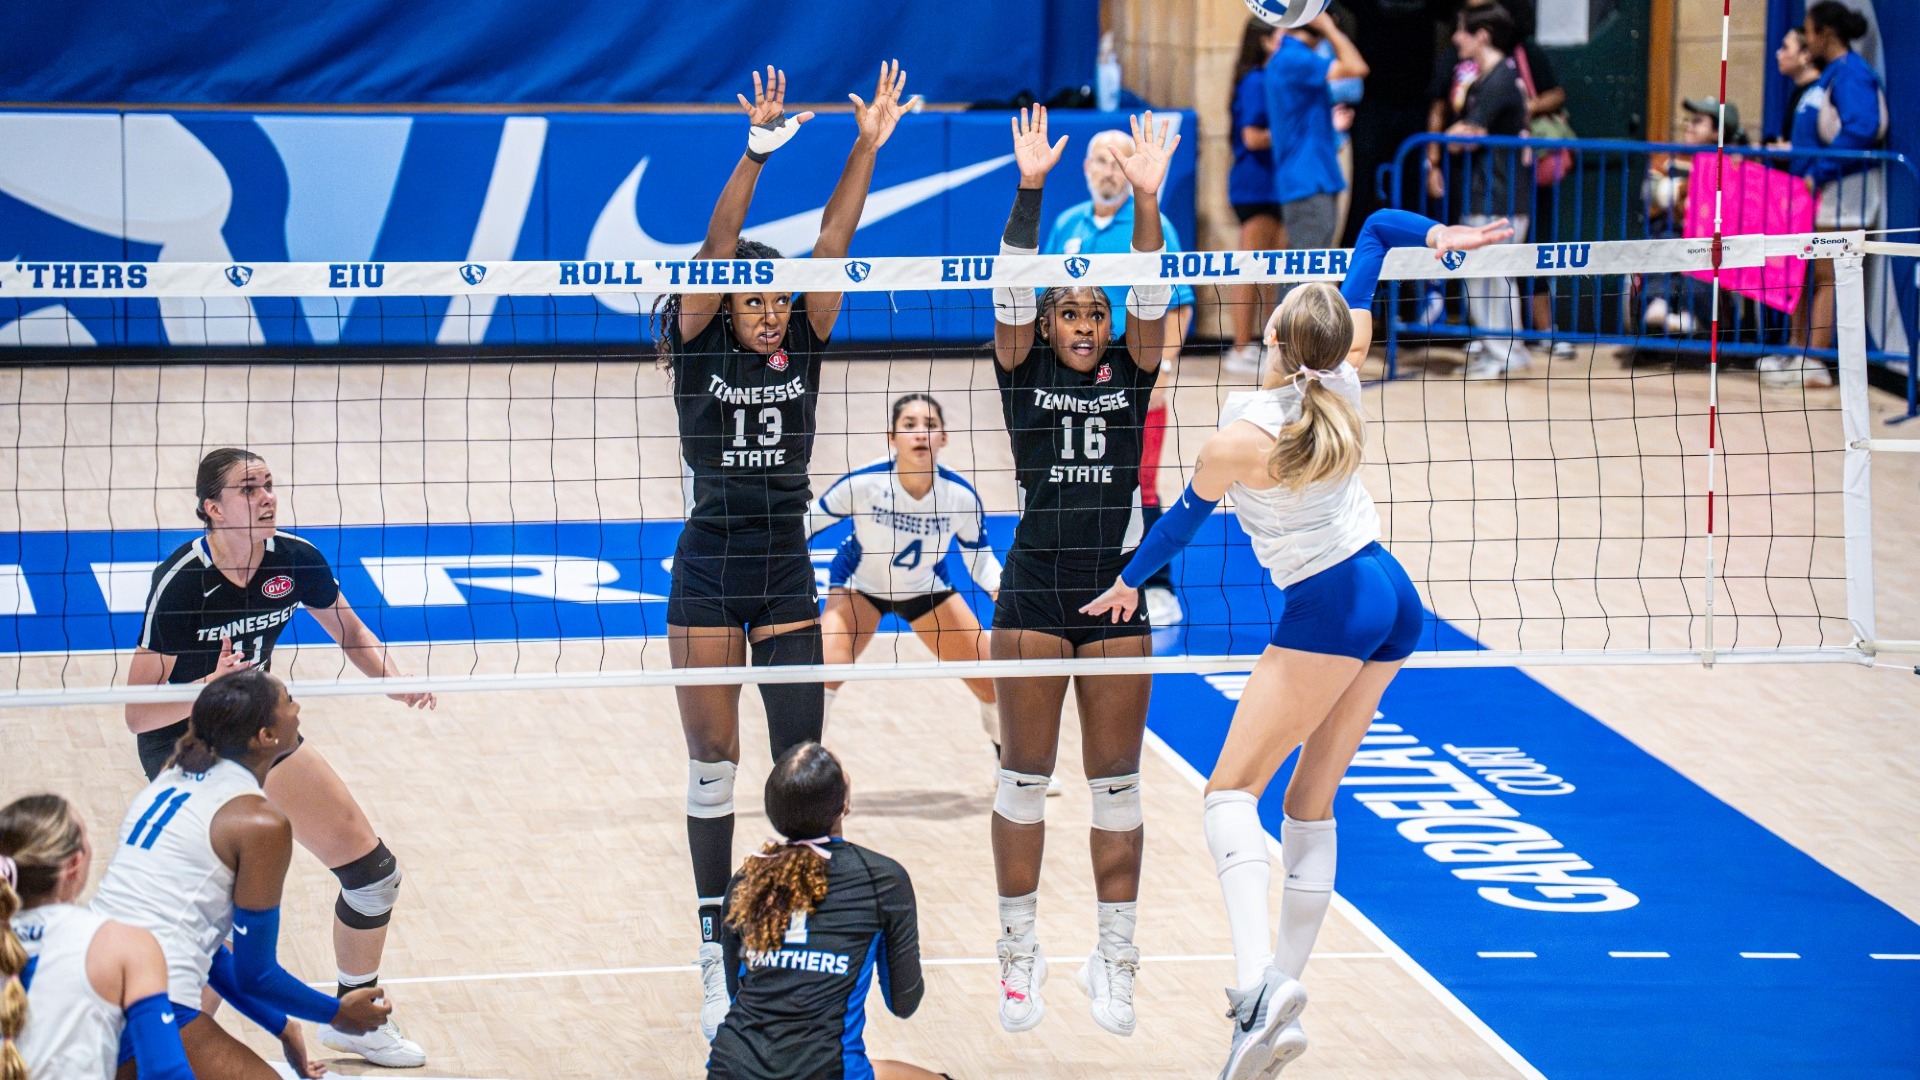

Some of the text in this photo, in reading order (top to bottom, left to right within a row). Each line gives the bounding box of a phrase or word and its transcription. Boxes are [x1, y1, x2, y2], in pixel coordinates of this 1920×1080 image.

[1820, 237, 1848, 245] Senoh
[940, 257, 995, 282] EIU
[1159, 250, 1348, 278] ROLL 'THER
[1535, 243, 1591, 270] EIU
[15, 263, 148, 289] 'THERS
[328, 263, 385, 289] EIU
[558, 260, 774, 285] ROLL 'THERS
[708, 374, 806, 405] TENNESSEE
[1033, 388, 1130, 414] TENNESSEE
[732, 406, 783, 447] 13
[1061, 416, 1107, 460] 16
[720, 448, 787, 467] STATE
[1048, 465, 1115, 484] STATE
[893, 539, 923, 571] 4
[268, 581, 287, 593] OVC
[232, 635, 264, 665] 11
[1441, 743, 1576, 796] COURT
[126, 786, 192, 851] 11
